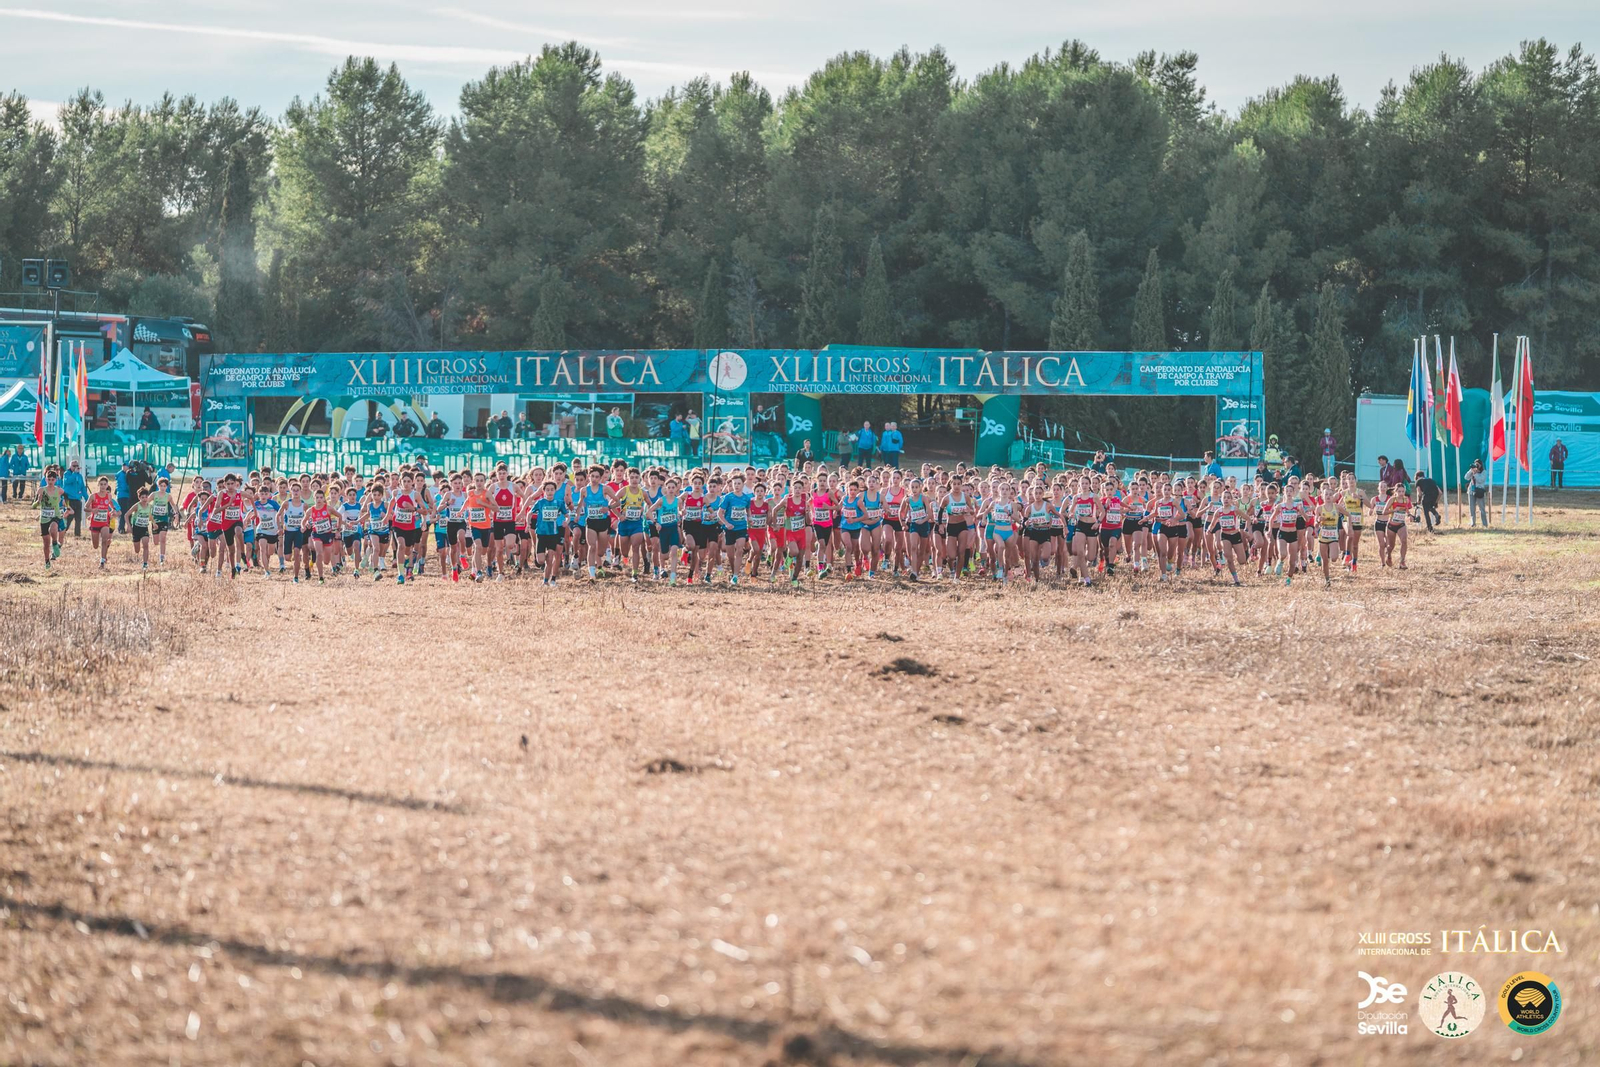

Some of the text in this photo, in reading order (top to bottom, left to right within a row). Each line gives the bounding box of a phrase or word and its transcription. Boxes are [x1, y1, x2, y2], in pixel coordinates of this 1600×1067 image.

[209, 365, 317, 375] CAMPEONATO DE ANDALUCÍA
[347, 359, 487, 386] XLIII CROSS
[515, 350, 661, 386] ITÁLICA
[769, 356, 910, 382] XLIII CROSS
[938, 351, 1087, 387] ITÁLICA
[1140, 364, 1252, 373] CAMPEONATO DE ANDALUCÍA
[225, 374, 236, 382] DE
[236, 374, 264, 382] CAMPO
[272, 372, 301, 381] TRAVÉS
[427, 375, 510, 384] INTERNACIONAL
[849, 374, 932, 383] INTERNACIONAL
[1157, 373, 1168, 381] DE
[1168, 373, 1197, 381] CAMPO
[1205, 371, 1235, 380] TRAVÉS
[258, 380, 285, 388] CLUBES
[768, 383, 918, 393] INTERNATIONAL CROSS COUNTRY
[1174, 379, 1219, 388] POR CLUBES
[347, 384, 494, 396] INTERNATIONAL CROSS COUNTRY
[1555, 405, 1583, 413] Sevilla
[1550, 423, 1582, 432] Sevilla
[397, 511, 412, 519] 7953
